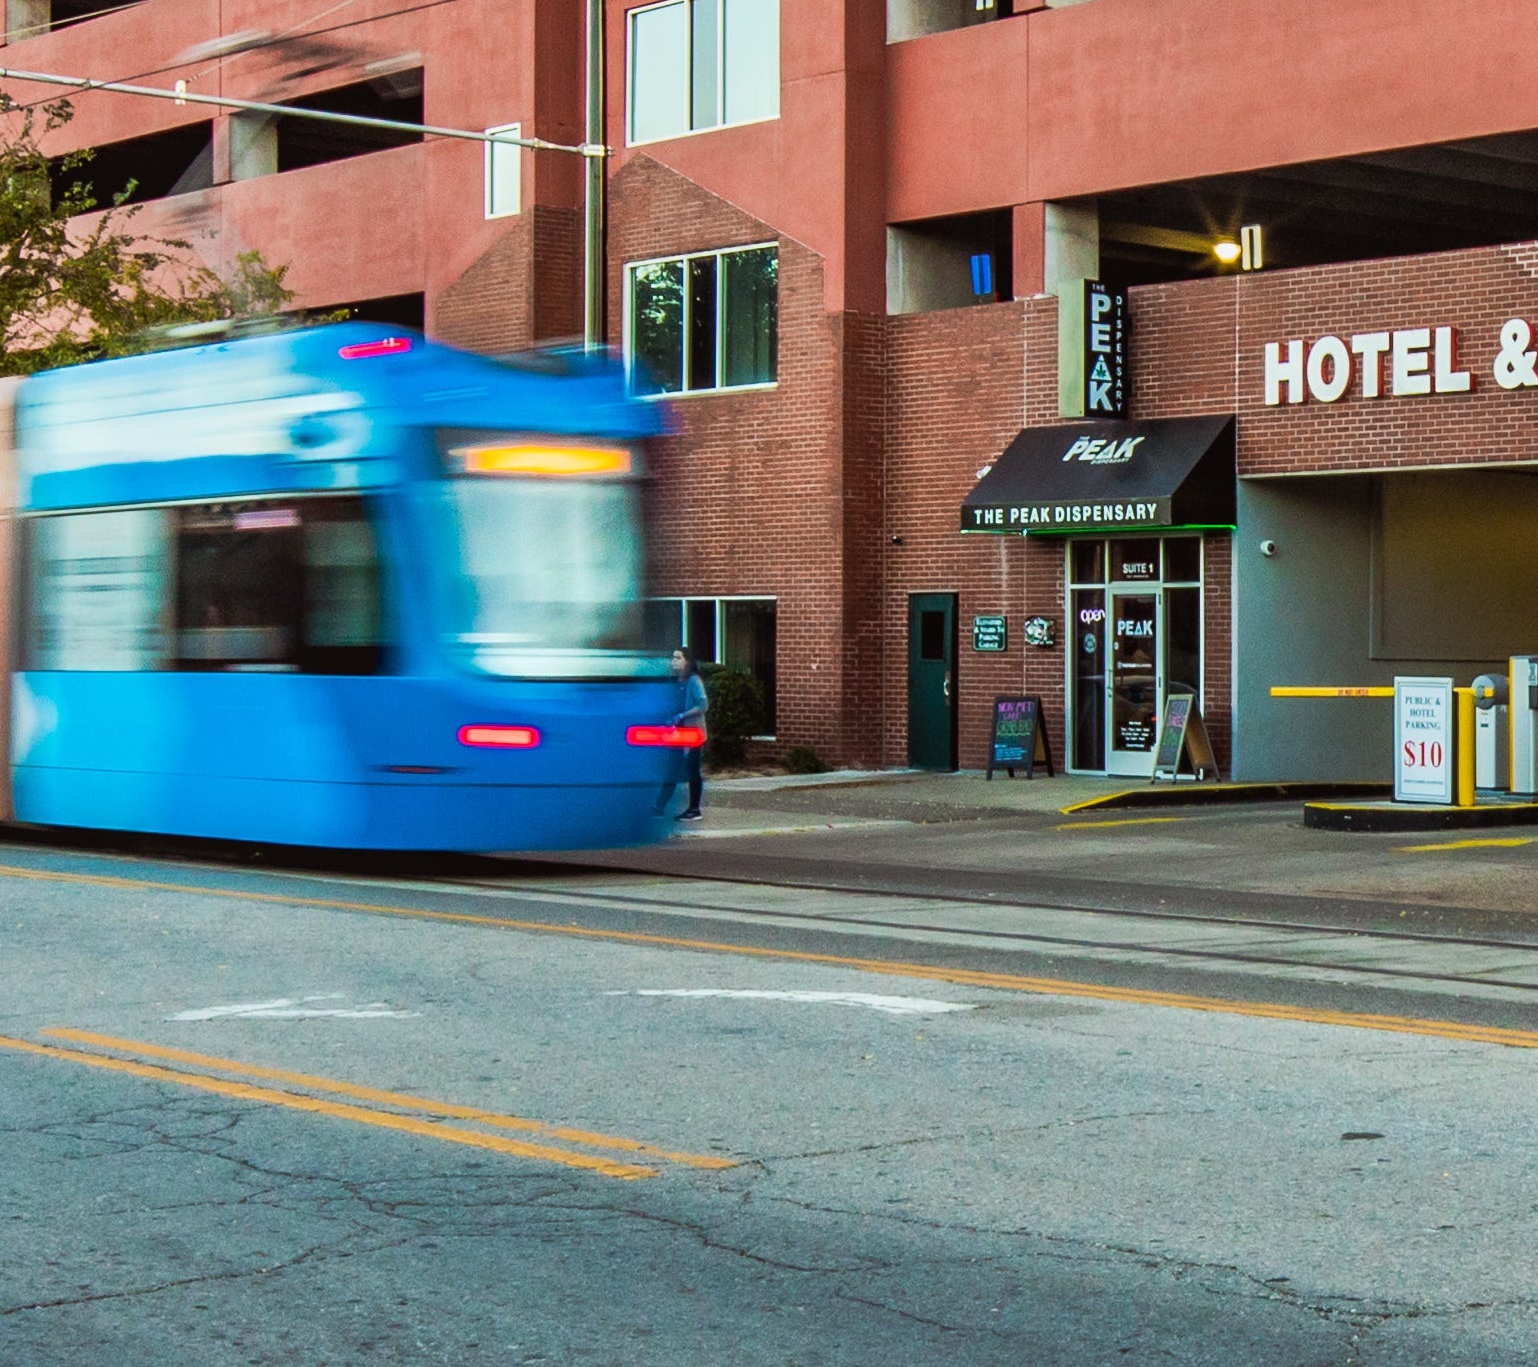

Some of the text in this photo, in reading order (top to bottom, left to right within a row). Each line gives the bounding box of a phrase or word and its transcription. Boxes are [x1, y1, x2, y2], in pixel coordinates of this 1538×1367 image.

[1089, 292, 1114, 412] PEAK
[1115, 295, 1123, 412] DISPENSARY
[1264, 325, 1472, 406] HOTEL
[1062, 436, 1146, 462] PEAK
[974, 503, 1158, 525] THE PEAK DISPENSARY
[1122, 563, 1154, 574] SUITE 1
[1117, 619, 1153, 636] PEAK
[1405, 696, 1441, 705] PUBLIC &
[1409, 708, 1435, 717] HOTEL
[1405, 721, 1441, 730] PARKING
[1403, 740, 1443, 768] $10
